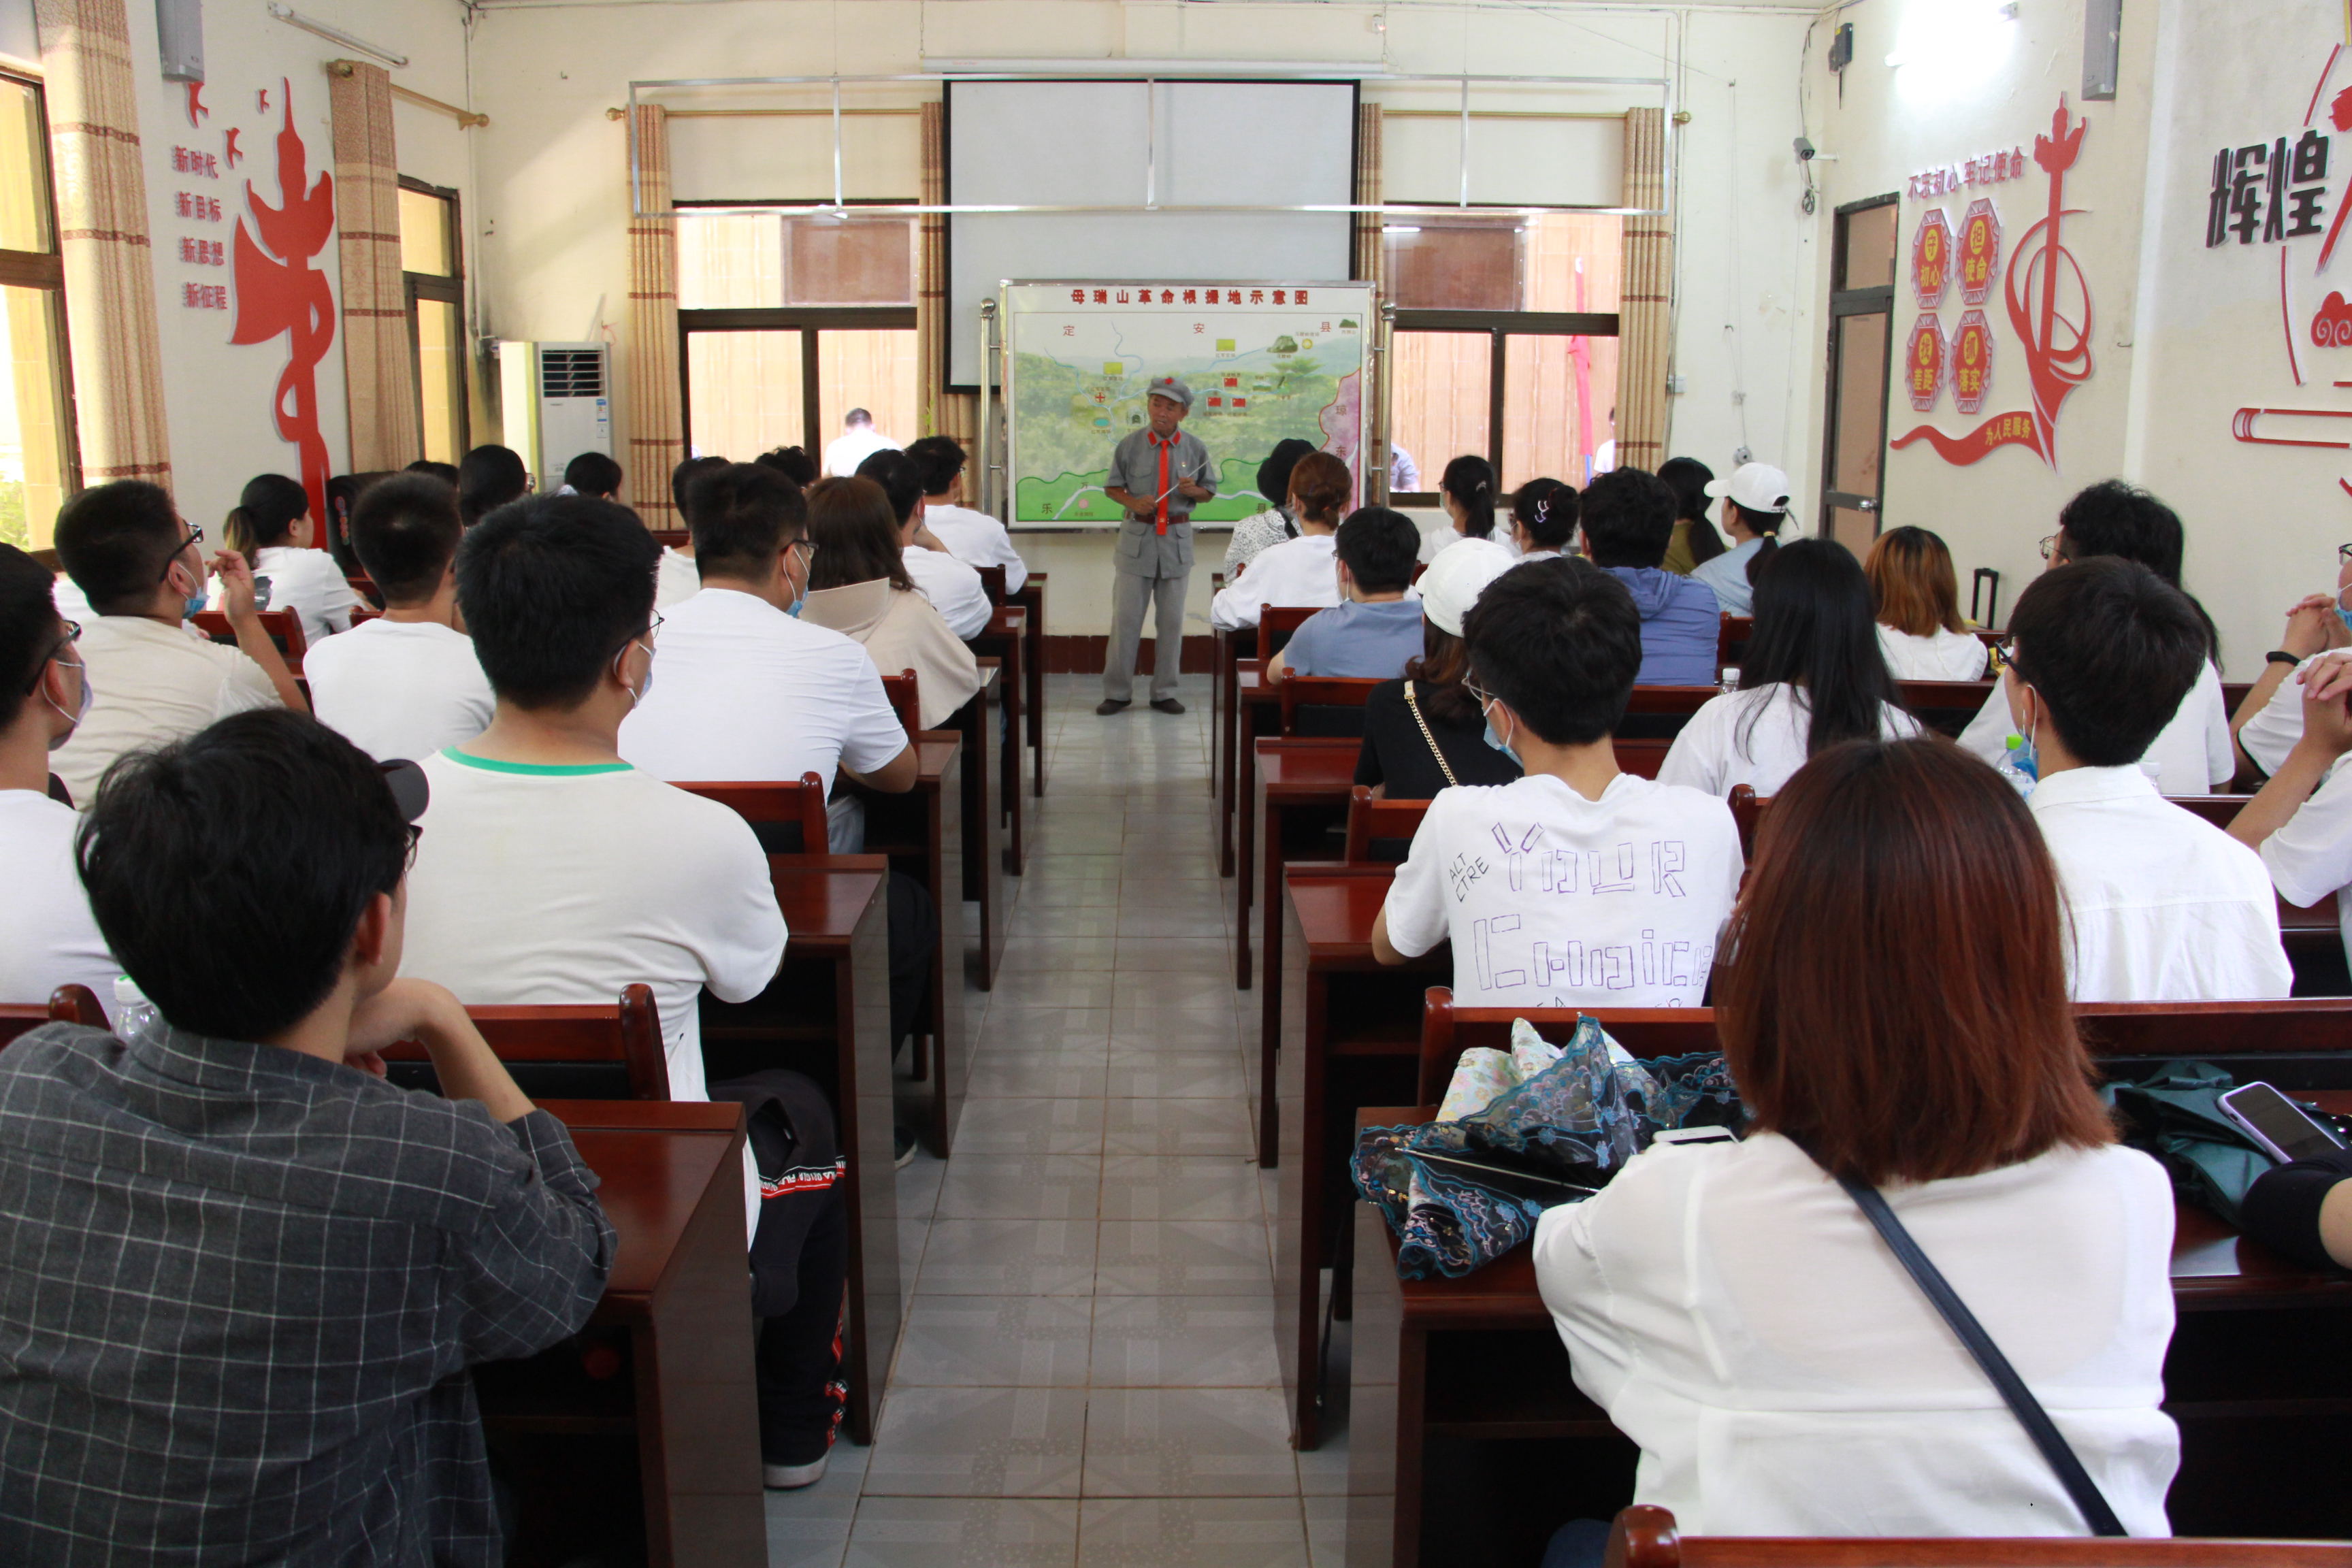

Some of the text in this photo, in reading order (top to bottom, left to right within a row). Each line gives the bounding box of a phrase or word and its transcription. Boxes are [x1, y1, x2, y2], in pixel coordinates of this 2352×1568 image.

[175, 145, 218, 179] 新时代
[2206, 129, 2329, 248] 辉煌
[179, 191, 222, 222] 新目标
[182, 236, 225, 266] 新思想
[1920, 265, 1940, 287] 初心
[1965, 256, 1987, 282] 使命
[186, 282, 228, 310] 新征程
[1071, 289, 1309, 306] 母瑞山革命根据地示意图
[1062, 321, 1331, 336] 定 安 县
[1914, 368, 1934, 391] 差距
[1959, 368, 1980, 392] 落实
[1985, 416, 2031, 446] 为人民服务
[1449, 851, 1466, 885] ALT
[1491, 822, 1686, 898] YOUR
